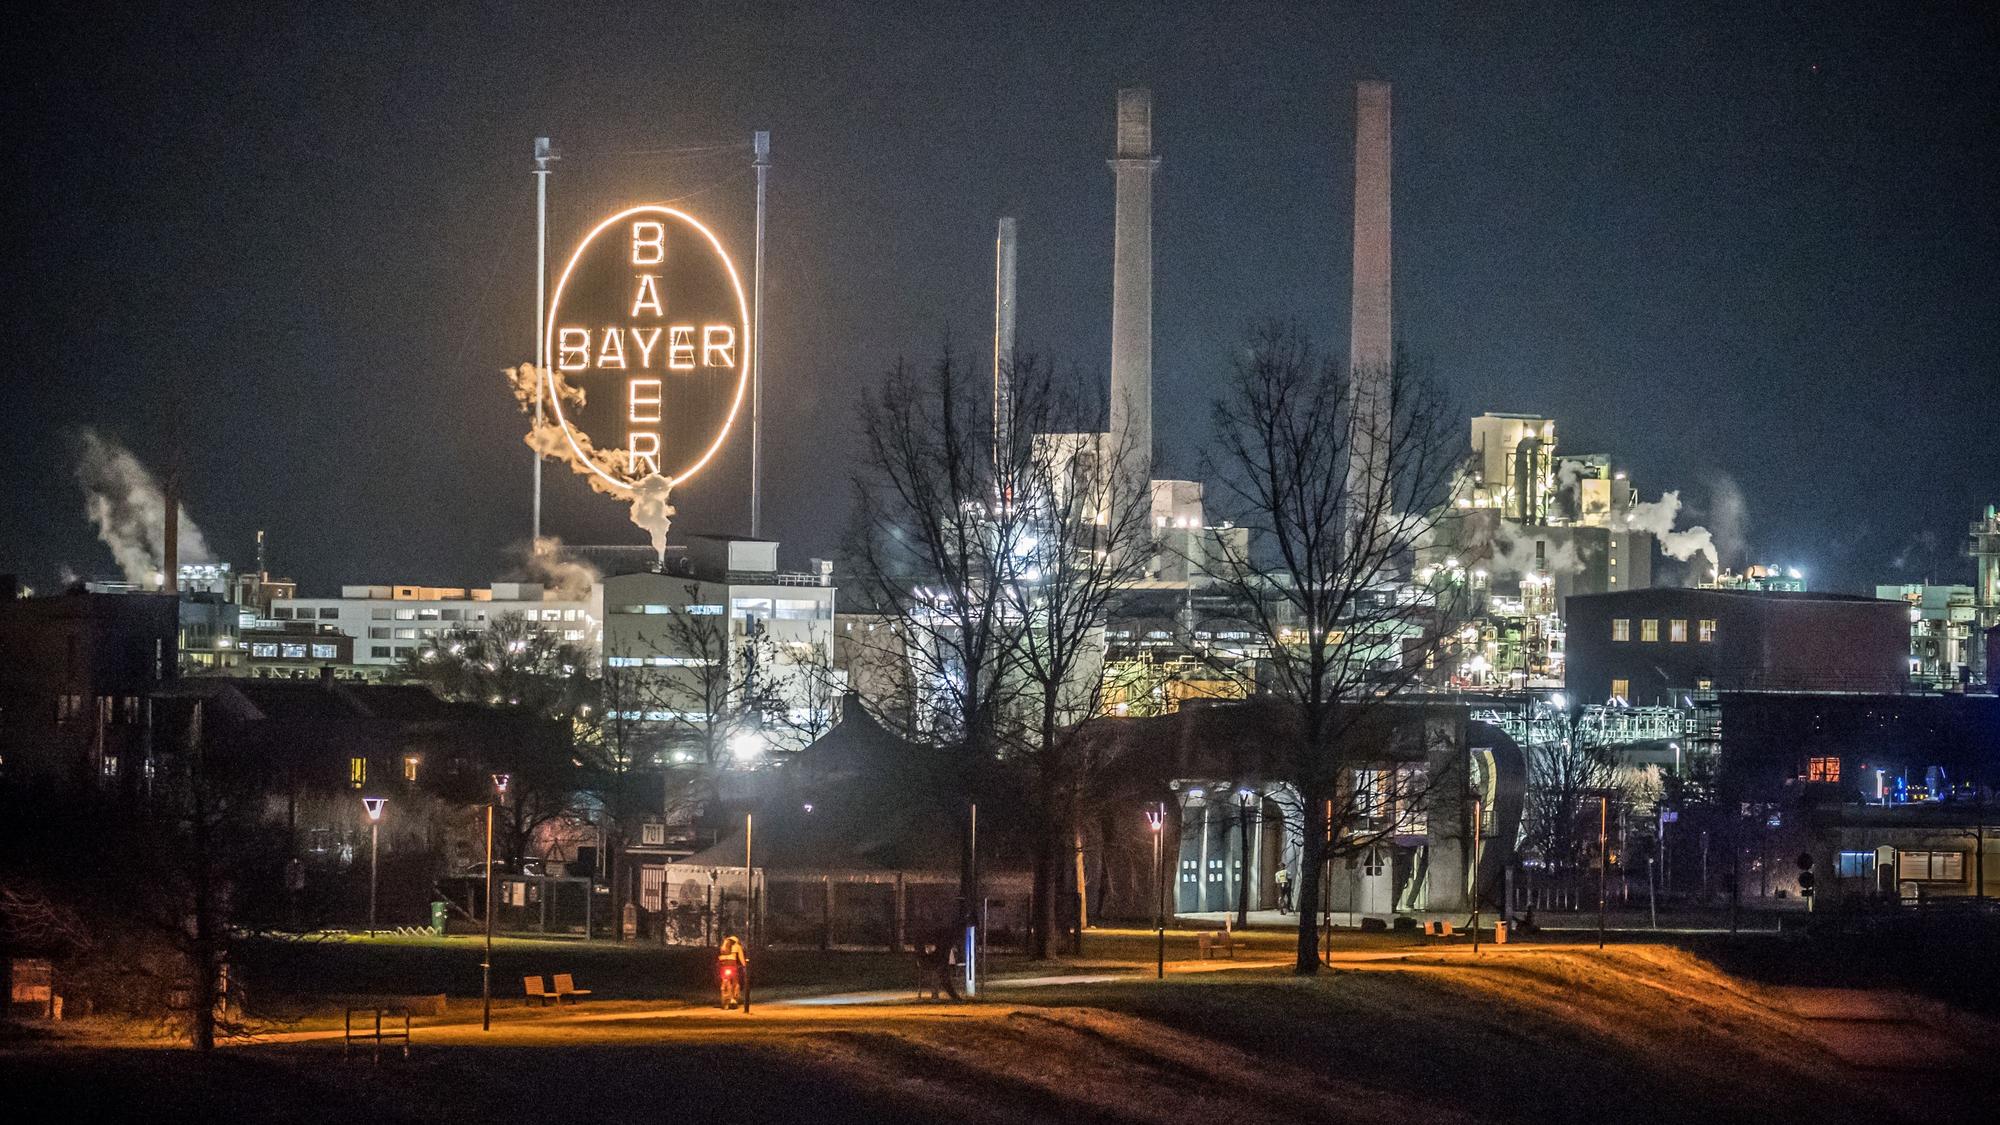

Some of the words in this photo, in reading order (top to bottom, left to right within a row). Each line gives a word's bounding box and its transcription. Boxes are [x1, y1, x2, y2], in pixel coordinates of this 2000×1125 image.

[558, 325, 736, 370] BAYER
[629, 221, 664, 474] BAYER
[645, 825, 660, 842] 701
